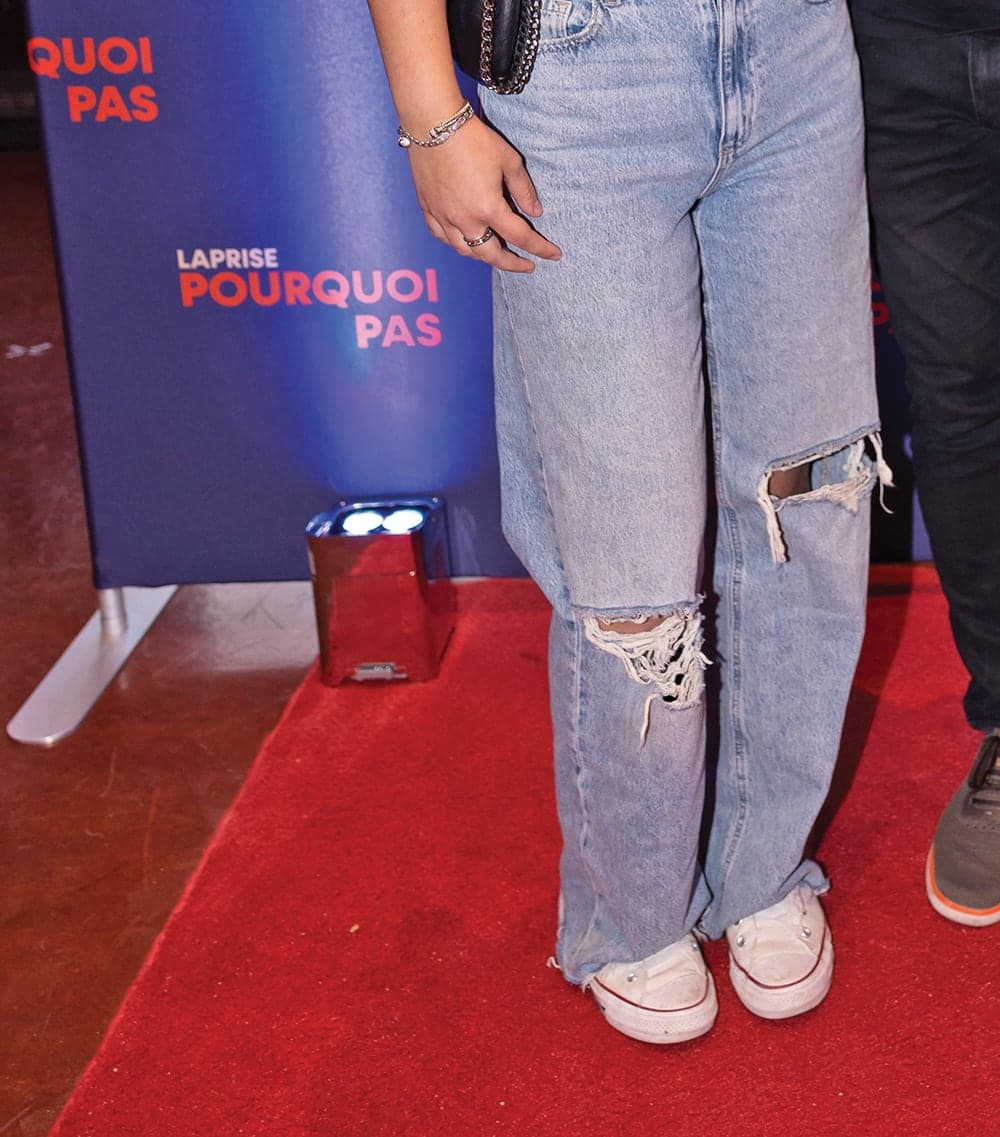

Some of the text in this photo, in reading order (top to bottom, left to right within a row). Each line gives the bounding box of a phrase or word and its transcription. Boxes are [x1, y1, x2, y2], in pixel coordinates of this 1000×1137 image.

[28, 37, 152, 79] QUOI
[67, 85, 158, 122] PAS
[177, 249, 278, 269] LAPRISE
[180, 269, 438, 307] POURQUOI
[356, 313, 441, 348] PAS
